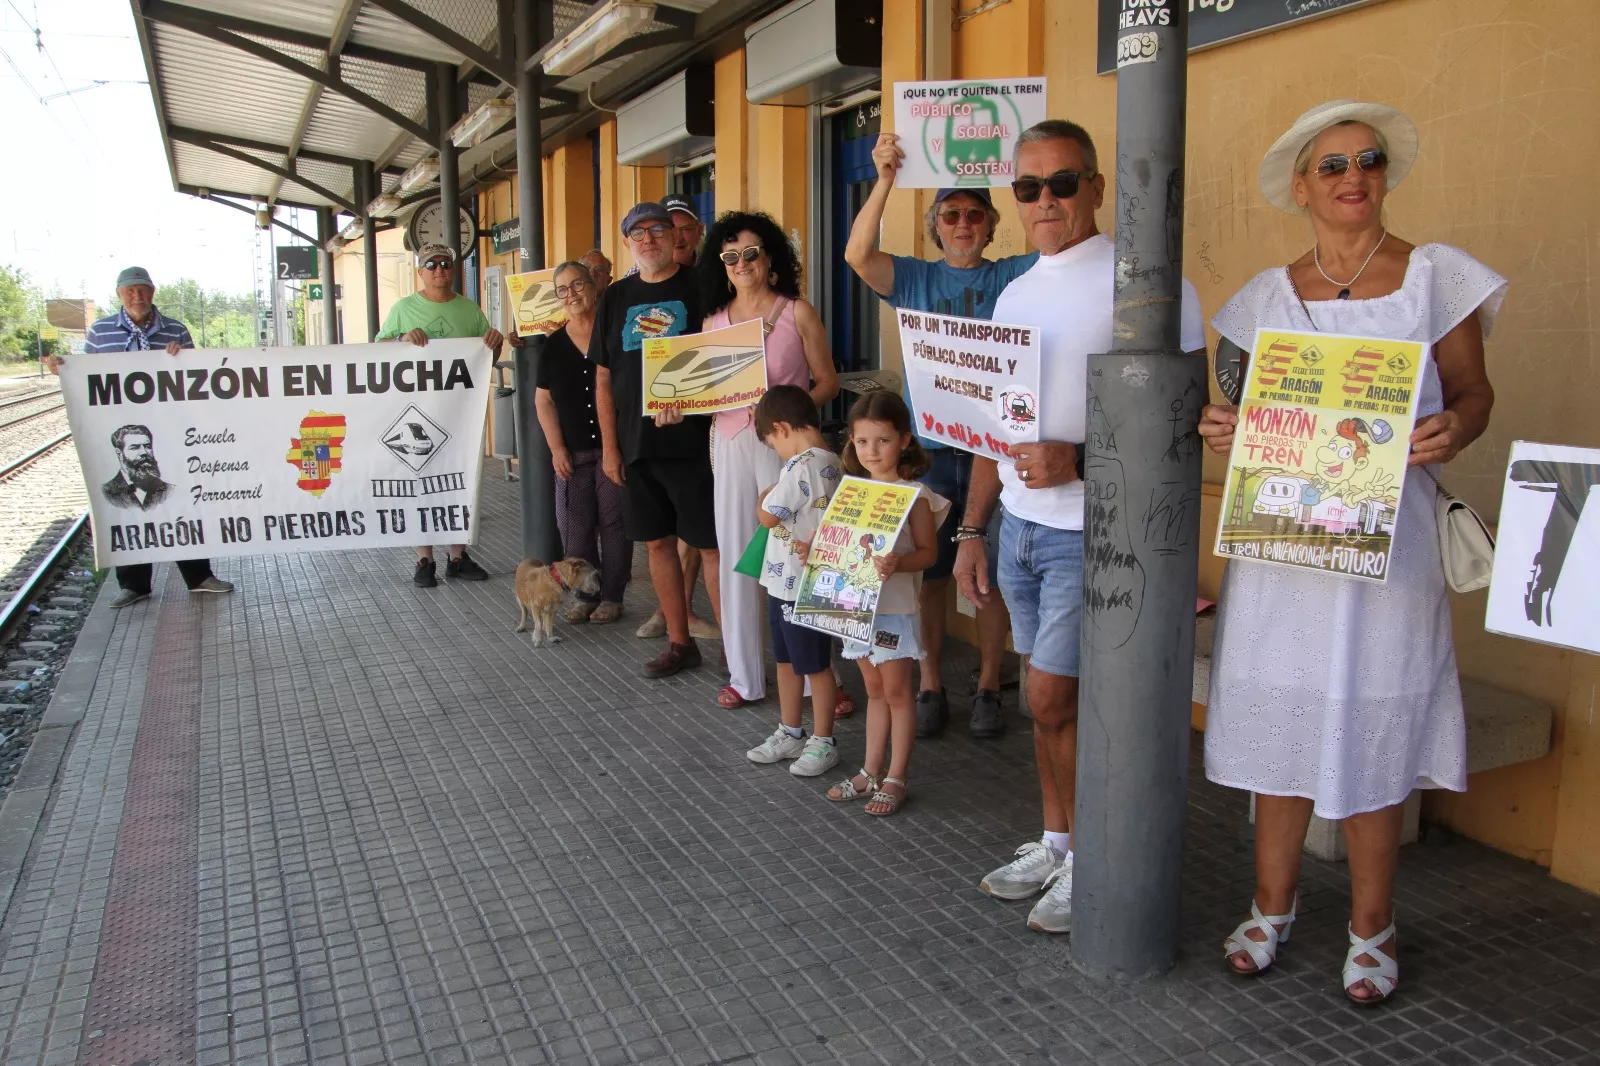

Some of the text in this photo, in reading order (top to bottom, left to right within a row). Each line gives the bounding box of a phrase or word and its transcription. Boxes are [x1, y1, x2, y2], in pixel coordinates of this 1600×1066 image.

[1119, 8, 1171, 30] HEAVS
[904, 84, 1042, 100] ¡QUE NO TE QUITEN EL TREN!
[912, 102, 972, 117] PÚBLICO
[958, 125, 1009, 138] SOCIAL
[932, 139, 942, 152] Y
[280, 262, 289, 278] 2
[900, 313, 1031, 346] POR UN TRANSPORTE
[1007, 359, 1017, 375] Y
[87, 358, 474, 406] MONZÓN EN LUCHA
[934, 374, 993, 402] ACCESIBLE
[1280, 377, 1323, 394] ARAGÓN
[1259, 391, 1320, 405] NO PIERDAS TU TREN
[1366, 385, 1411, 403] ARAGÓN
[1344, 399, 1407, 414] NO PIERDAS TU TREN
[1245, 405, 1317, 440] MONZÓN
[185, 427, 236, 446] Escuela
[922, 412, 1018, 459] Yo elijo tre
[1246, 434, 1258, 444] NO
[1297, 441, 1308, 449] TU
[187, 456, 249, 477] Despensa
[190, 483, 262, 505] Ferrocarril
[111, 515, 204, 552] ARAGÓN
[221, 516, 253, 544] NO
[265, 511, 366, 541] PIERDAS
[376, 508, 406, 534] TU
[818, 525, 853, 548] MONZÓN
[1220, 544, 1231, 553] EL
[1331, 545, 1386, 575] FUTURO
[844, 618, 870, 639] FUTURO
